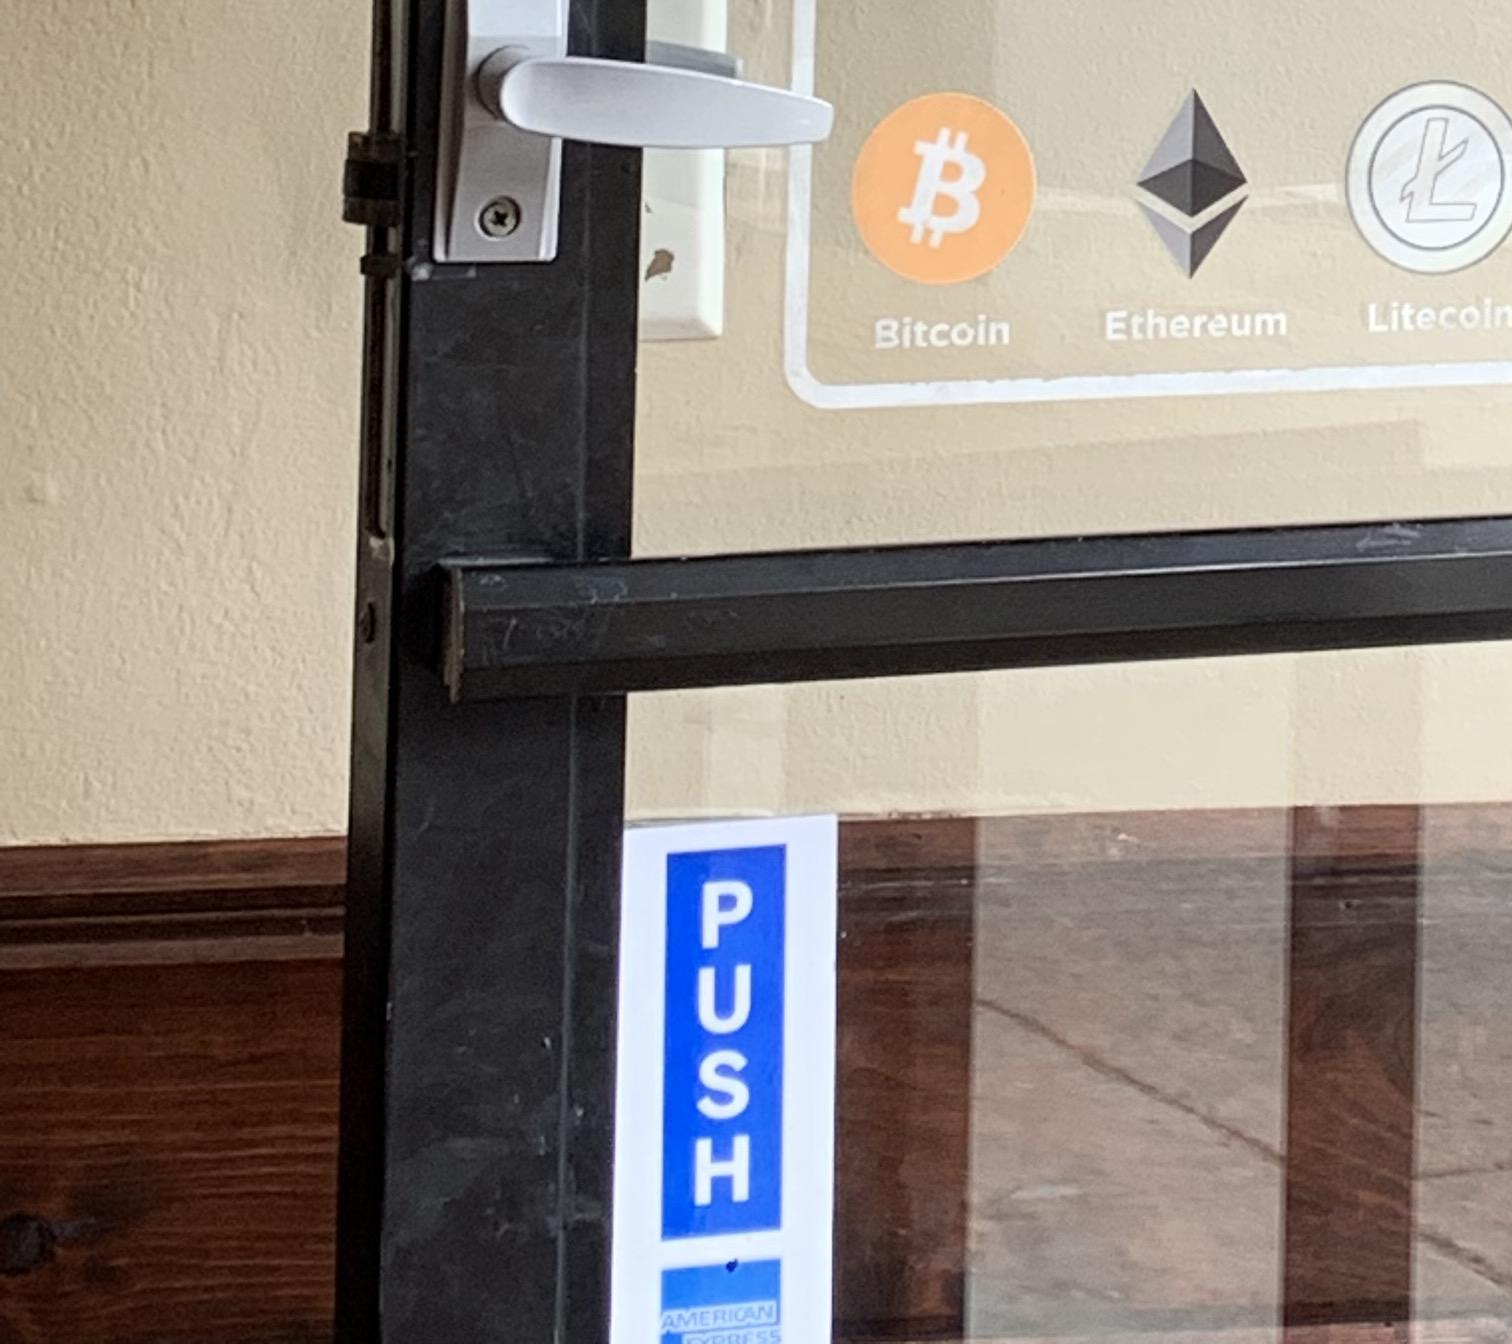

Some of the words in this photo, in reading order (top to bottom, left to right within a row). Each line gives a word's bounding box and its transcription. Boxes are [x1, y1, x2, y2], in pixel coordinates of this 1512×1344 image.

[873, 315, 1011, 349] Bitcoin
[1105, 308, 1288, 342] Ethereum
[693, 880, 754, 1206] PUSH
[661, 1302, 777, 1331] AMERICAN
[686, 1328, 782, 1344] EXPRESS
